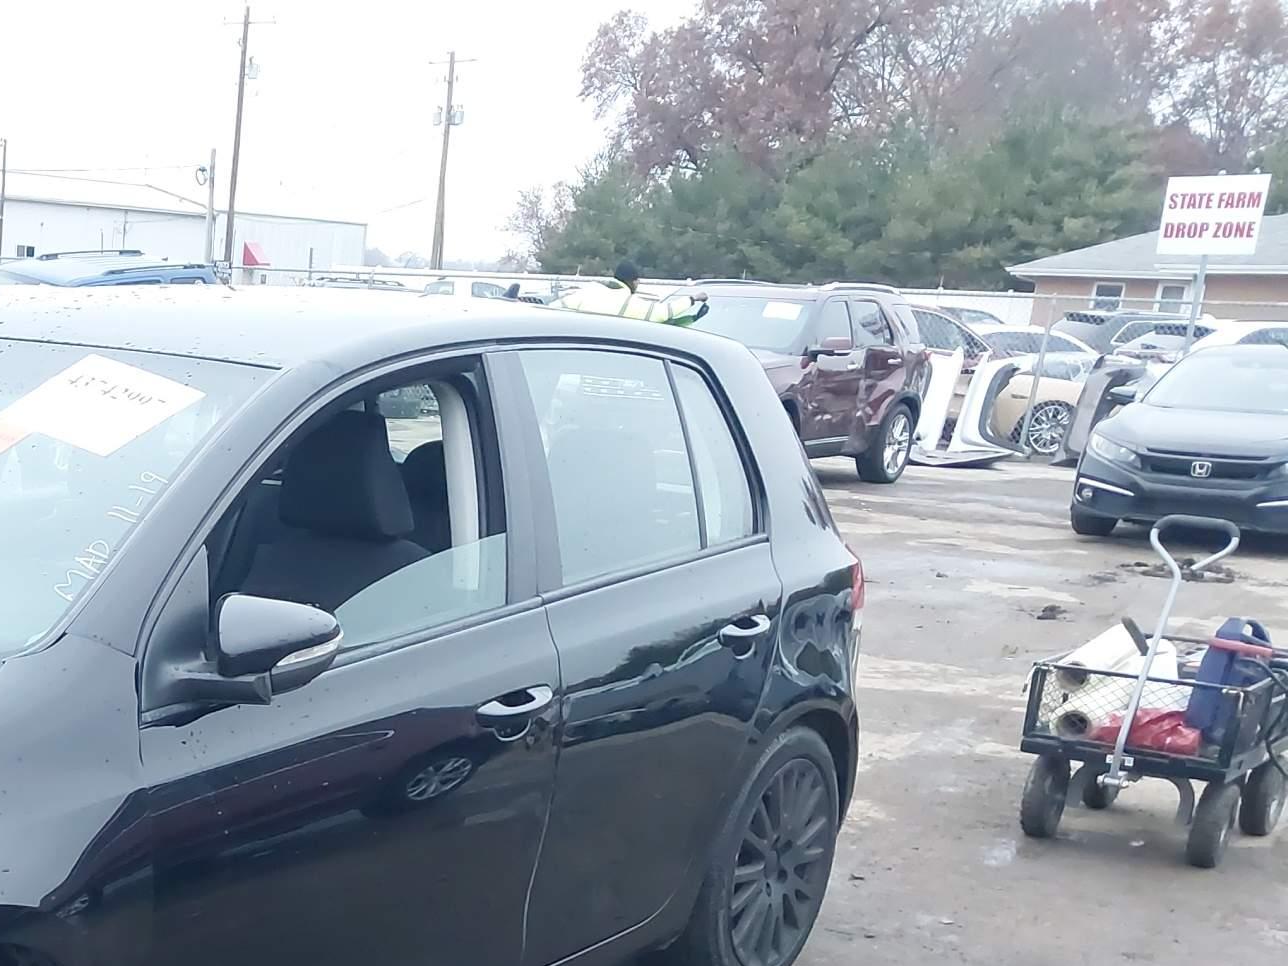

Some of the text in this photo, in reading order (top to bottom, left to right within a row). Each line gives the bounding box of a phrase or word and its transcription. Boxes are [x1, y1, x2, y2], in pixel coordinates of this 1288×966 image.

[1168, 191, 1263, 210] STATE FARM
[1163, 221, 1256, 239] DROP ZONE
[53, 470, 169, 602] MAD 11-19
